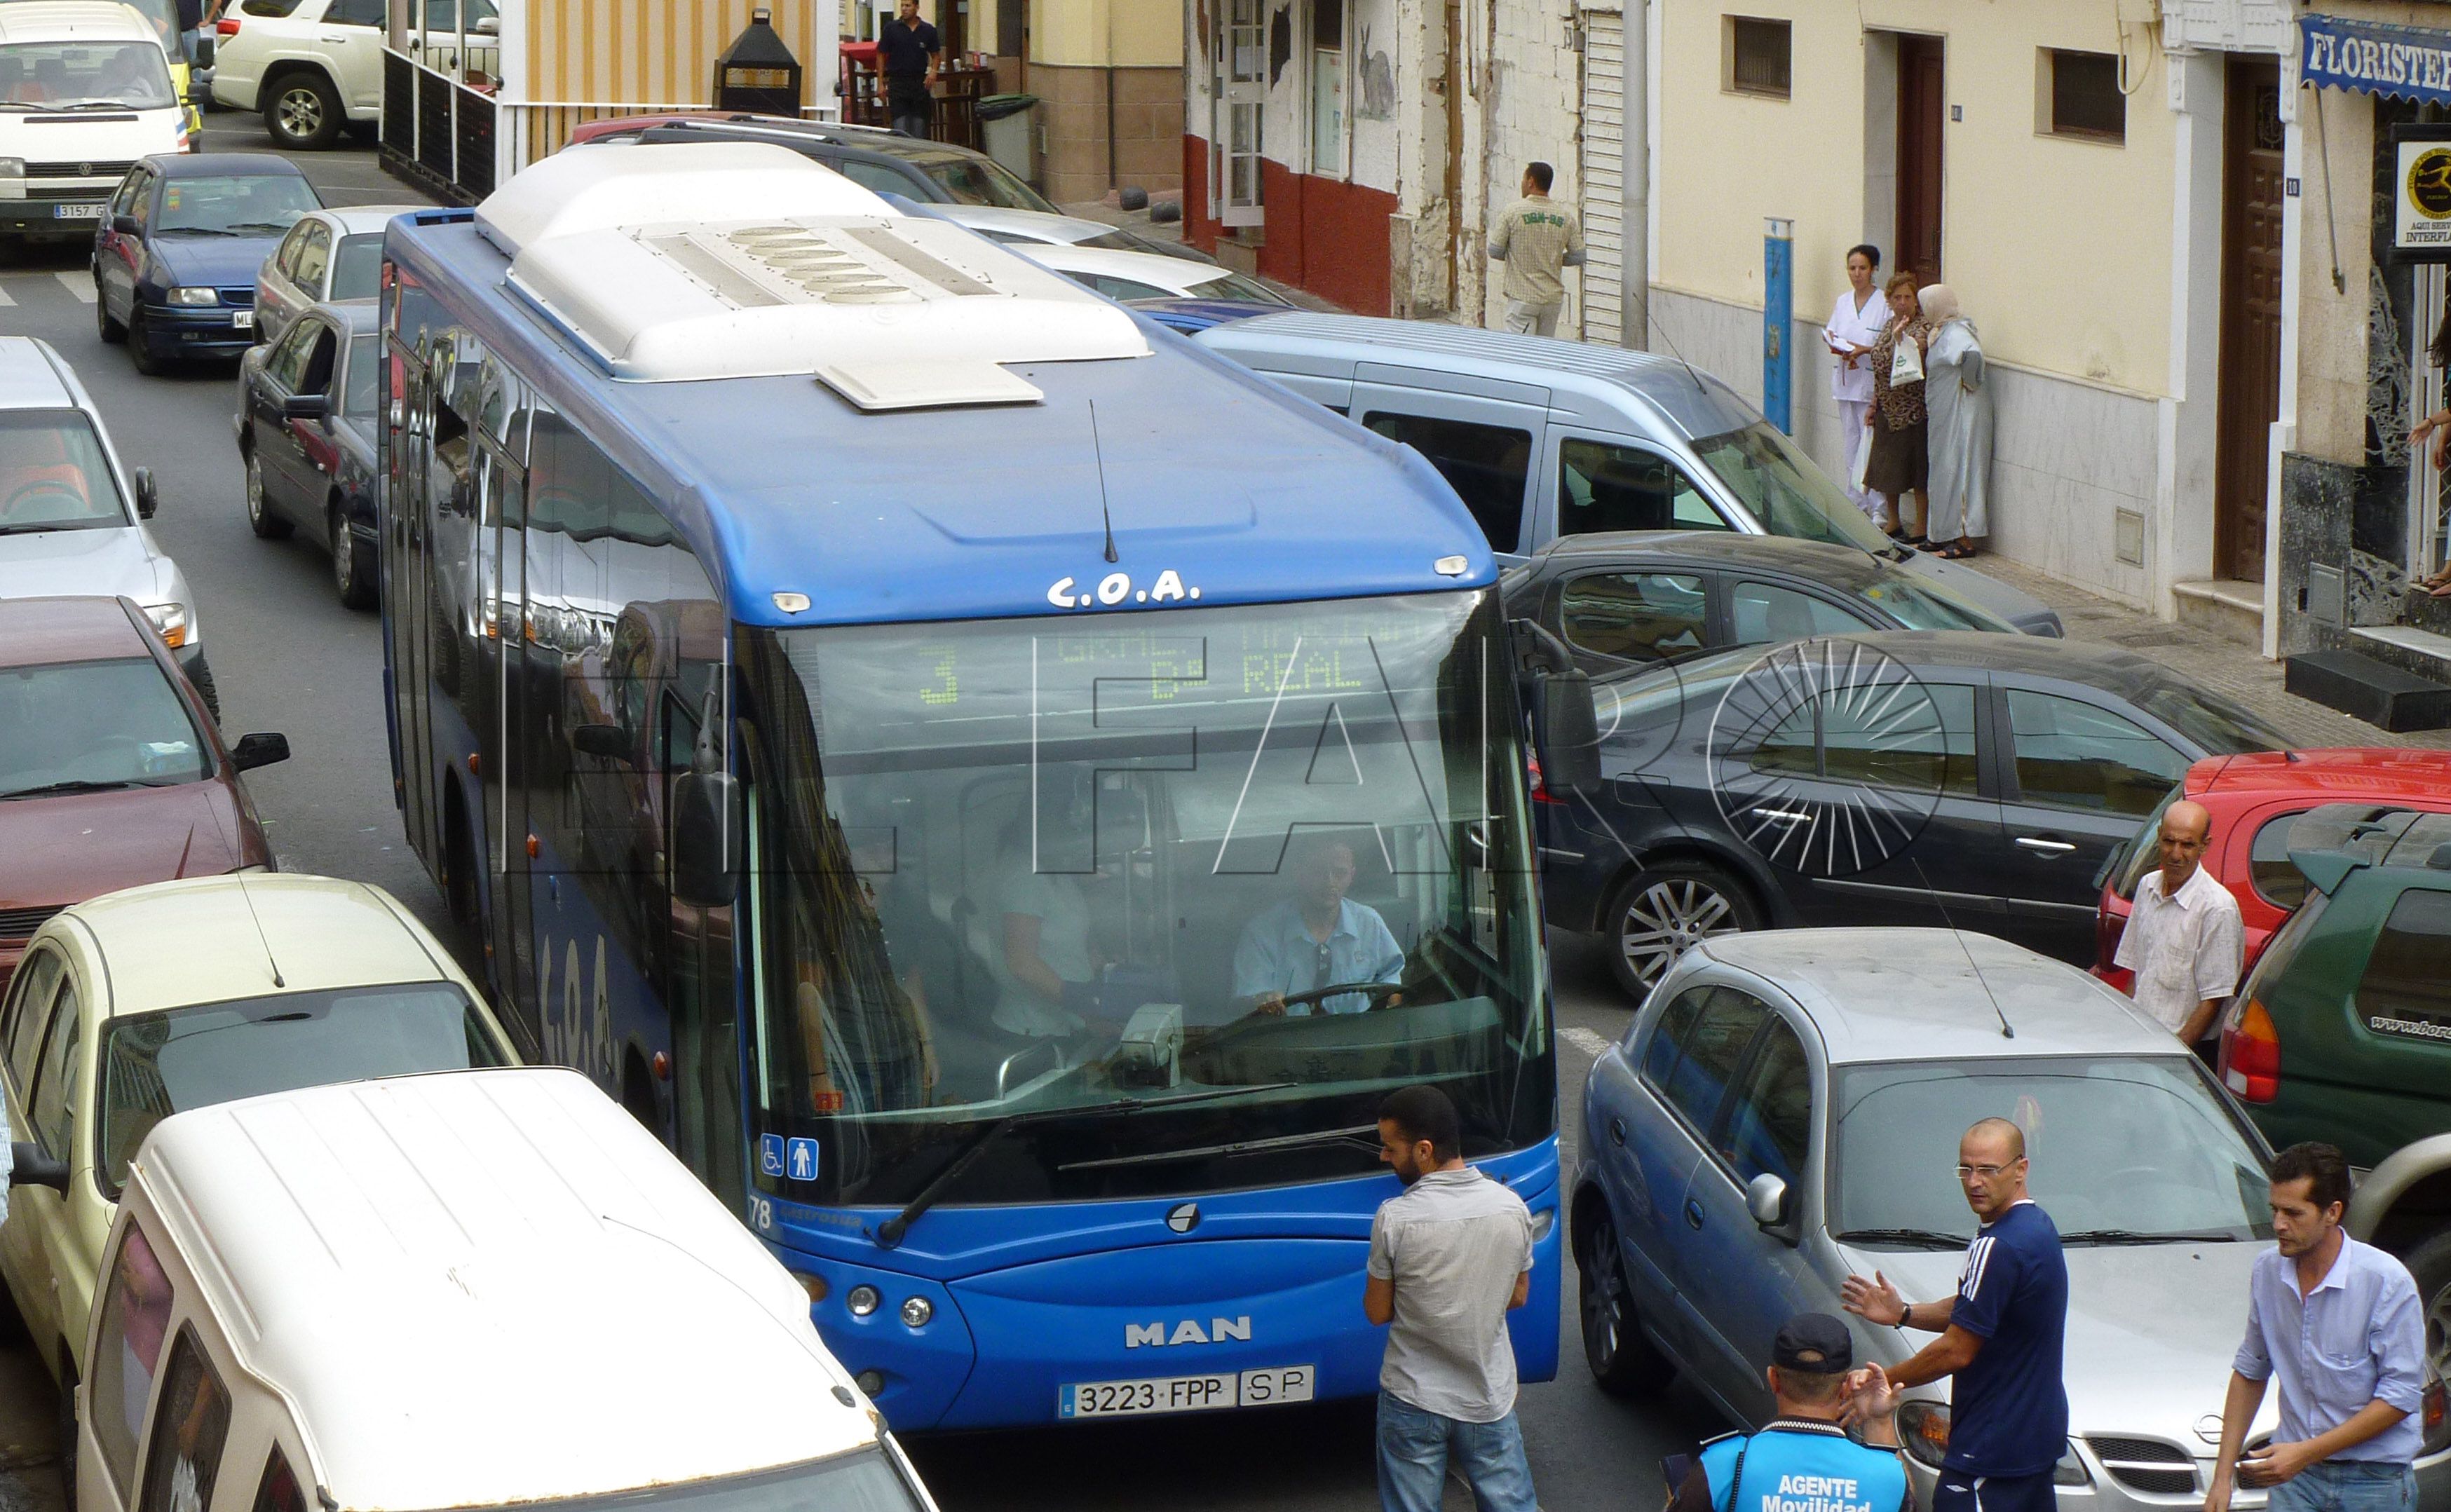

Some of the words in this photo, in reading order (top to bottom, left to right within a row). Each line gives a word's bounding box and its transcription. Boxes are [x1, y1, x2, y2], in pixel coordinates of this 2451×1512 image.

[2288, 181, 2297, 194] 10
[62, 206, 89, 217] 3157
[1047, 568, 1201, 611] C.O.A.
[919, 646, 958, 705] 3
[1244, 648, 1362, 693] REAL
[749, 1194, 771, 1229] 78
[1125, 1315, 1251, 1348] MAN
[1080, 1383, 1155, 1412] 3223
[1170, 1378, 1221, 1408] FPP
[1762, 1494, 1871, 1512] Movilidad
[1777, 1475, 1857, 1499] AGENTE
